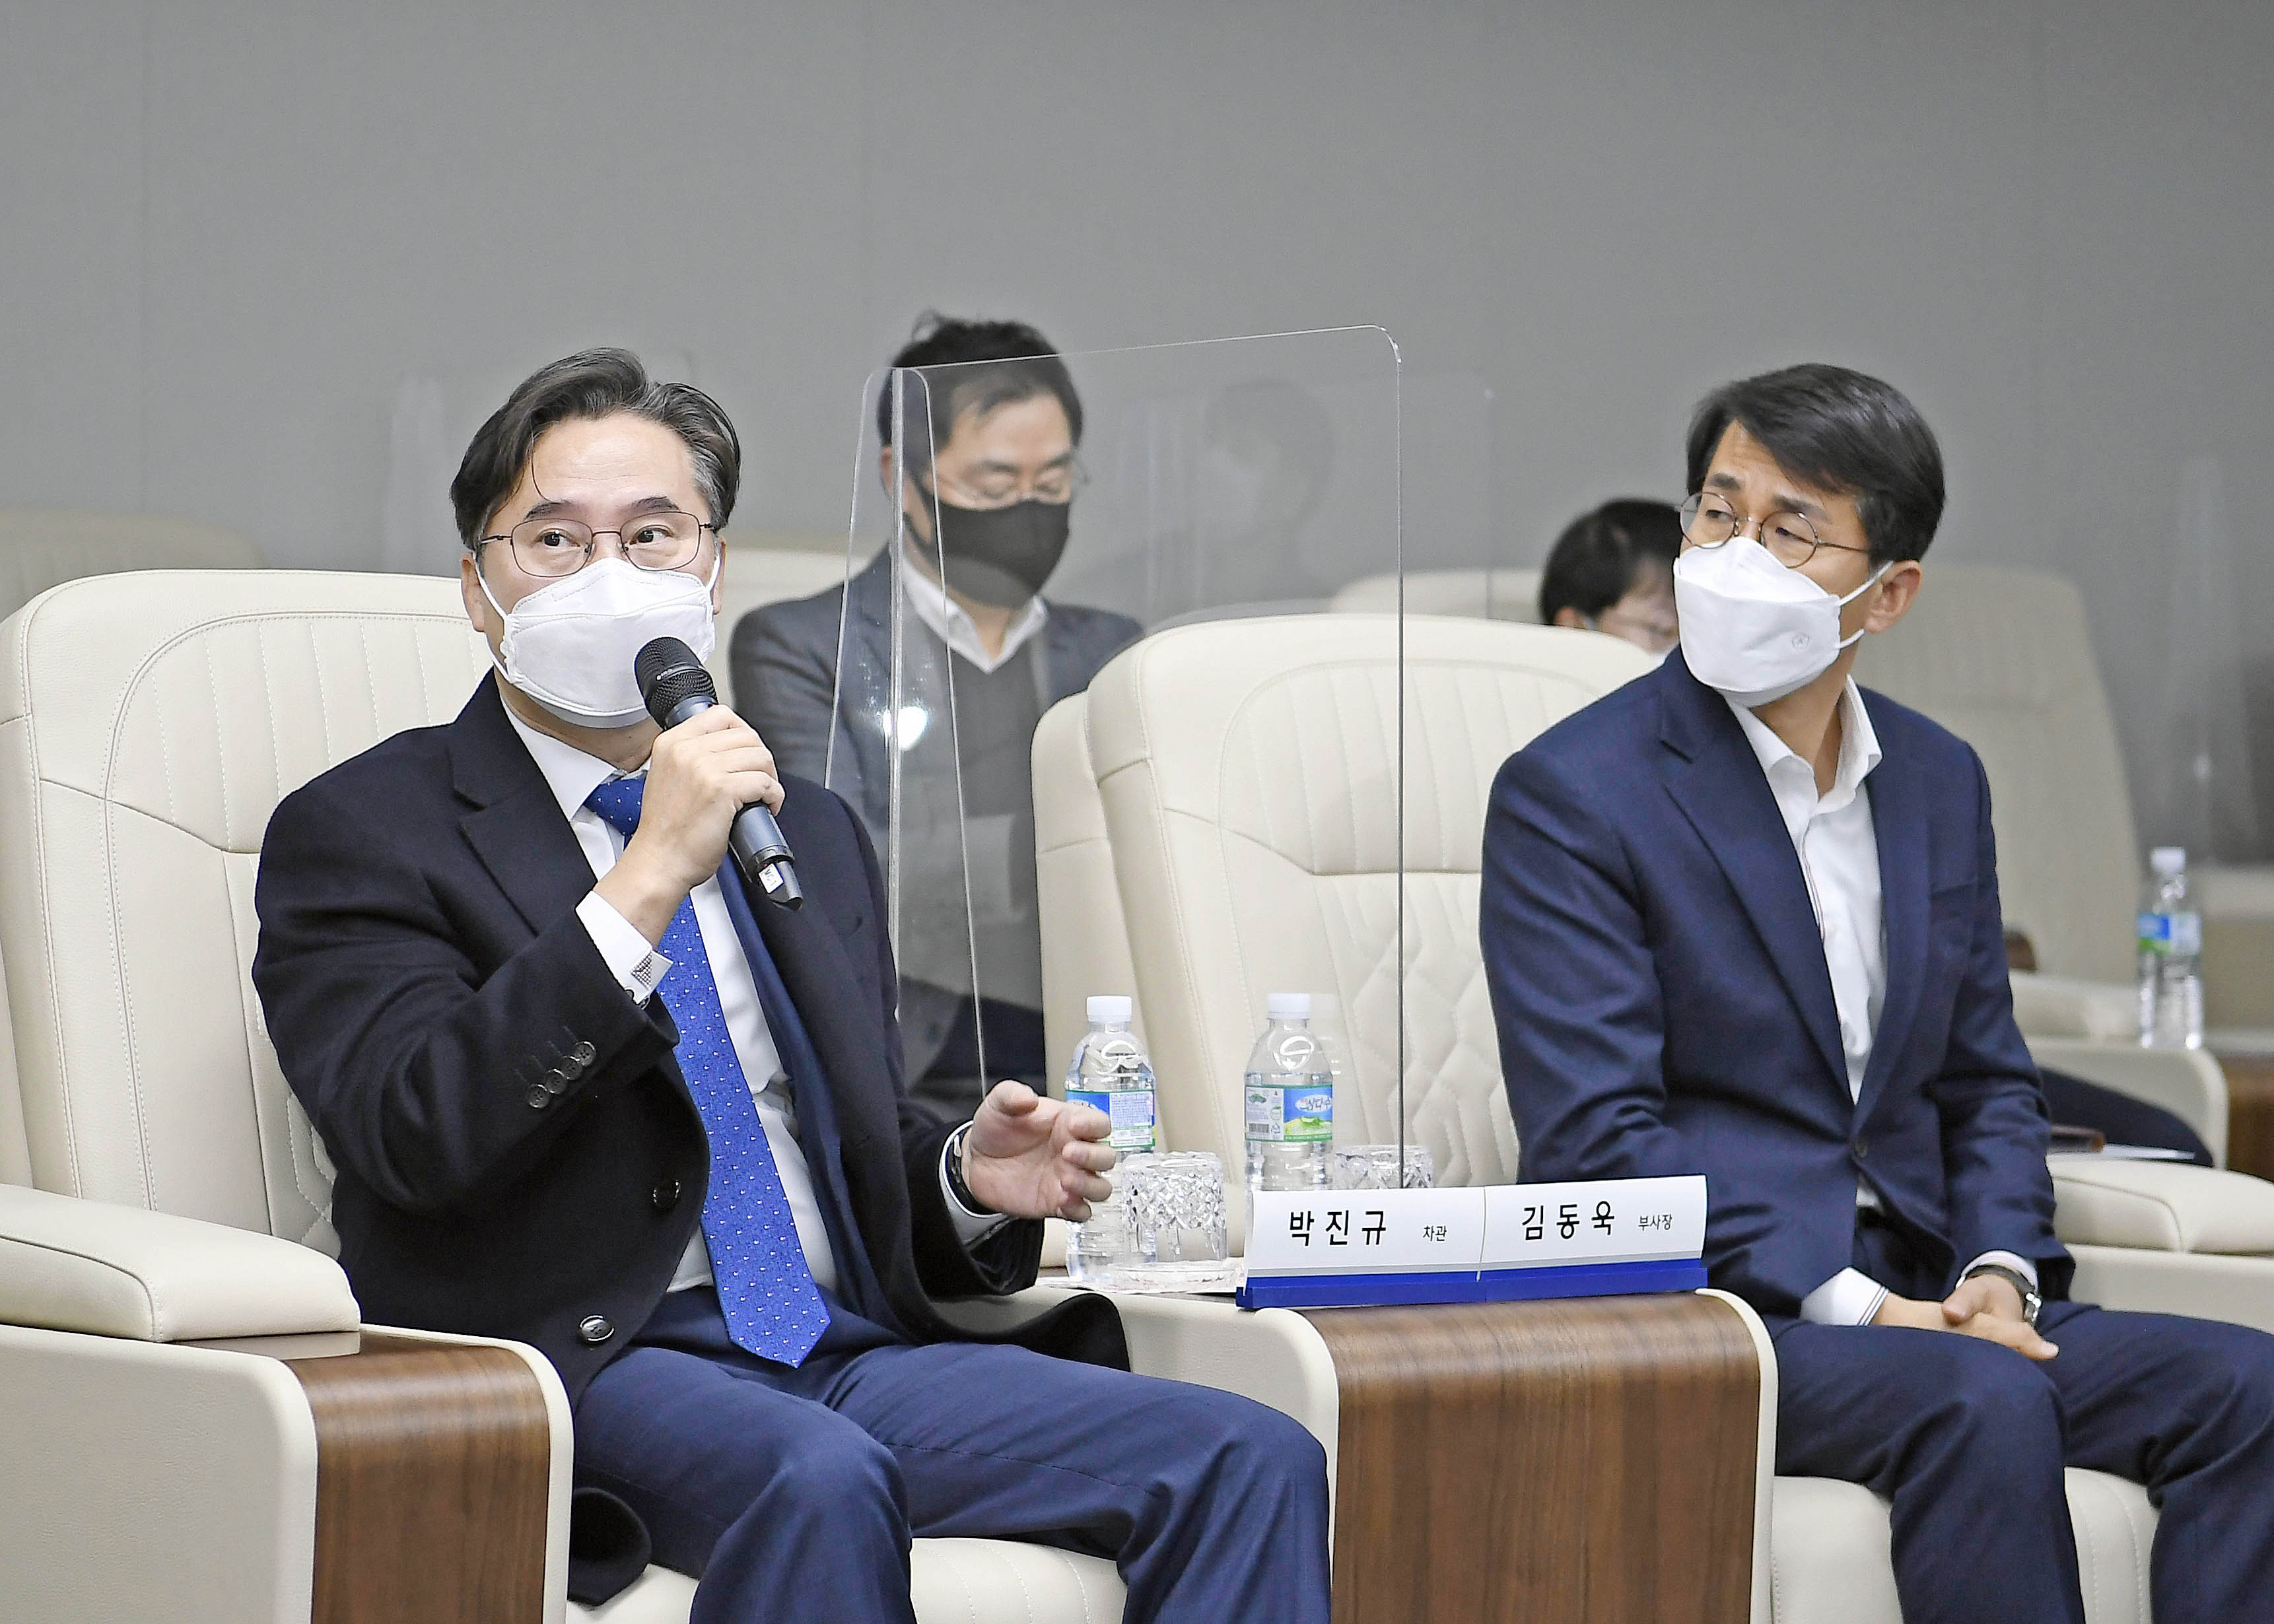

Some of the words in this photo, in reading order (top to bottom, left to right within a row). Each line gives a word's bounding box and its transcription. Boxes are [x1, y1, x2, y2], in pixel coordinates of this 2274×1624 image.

[1290, 1209, 1387, 1247] 박진규
[1422, 1225, 1447, 1242] 차관
[1521, 1200, 1615, 1241] 김동욱
[1638, 1213, 1672, 1232] 부사장
